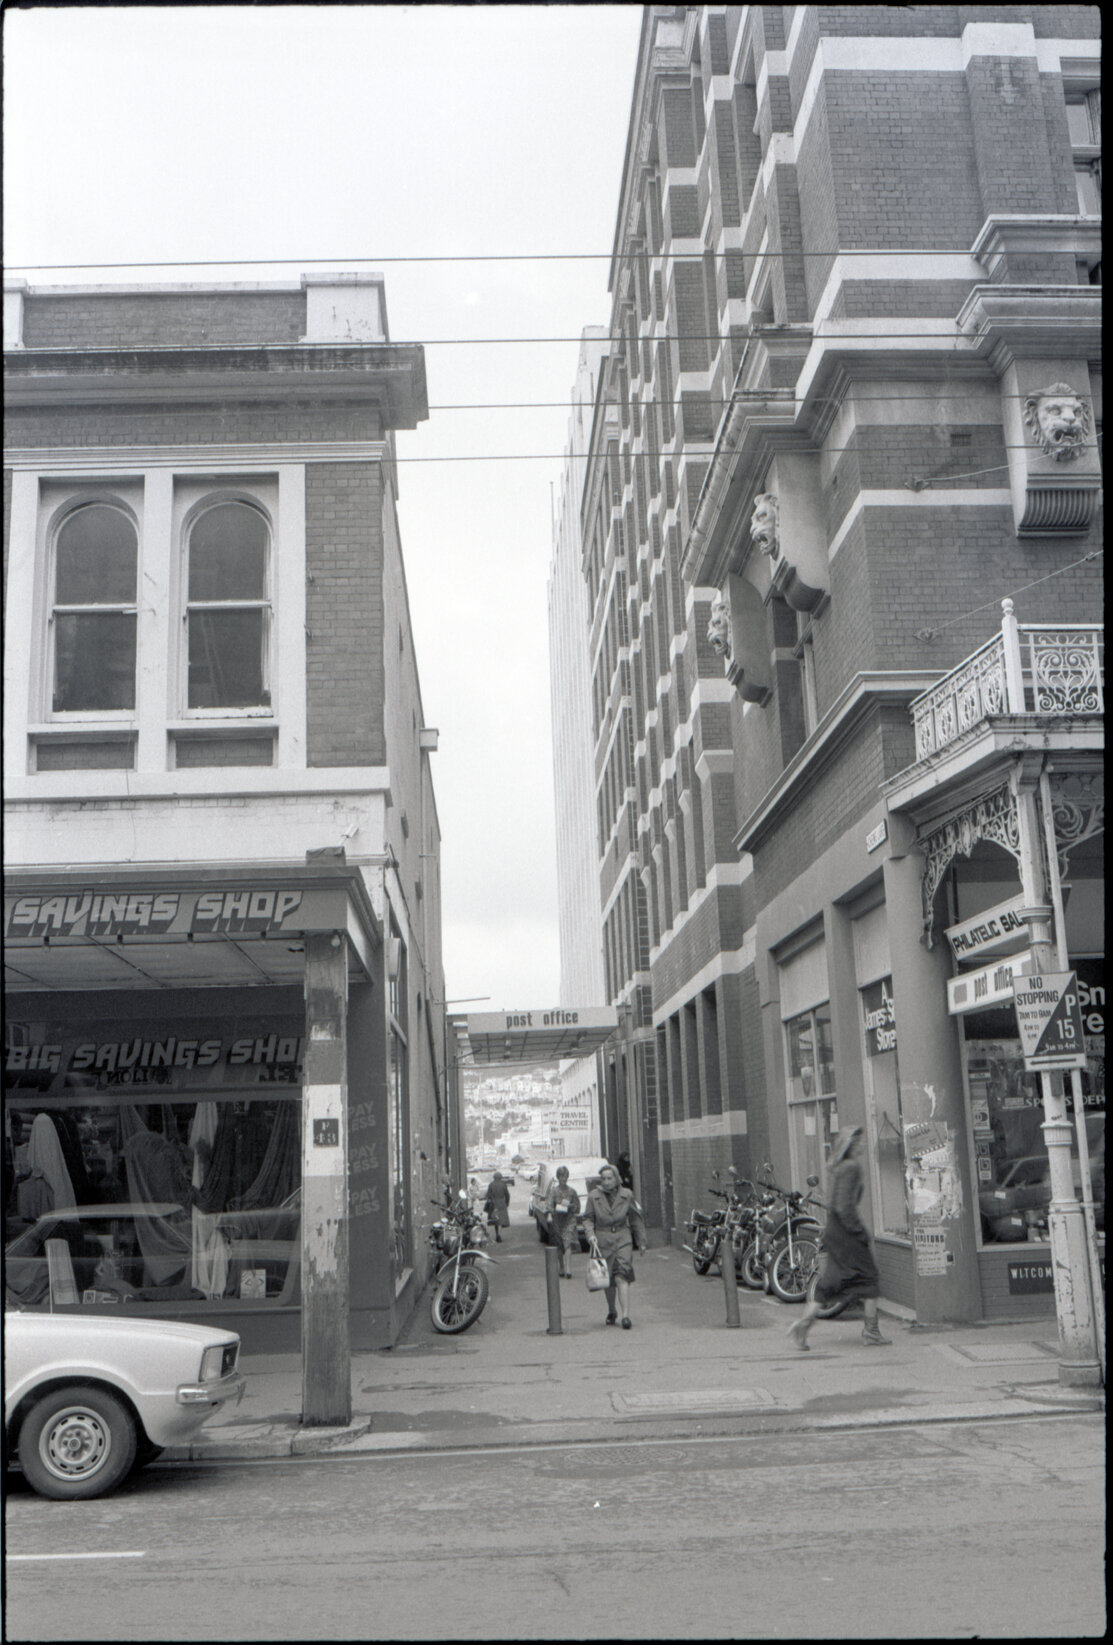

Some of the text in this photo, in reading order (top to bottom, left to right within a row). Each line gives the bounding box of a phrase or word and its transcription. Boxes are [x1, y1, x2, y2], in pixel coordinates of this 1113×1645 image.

[12, 889, 303, 930] SAVINGS SHOP
[952, 919, 1001, 953] PHILATELIC
[974, 965, 1013, 1002] post office
[1028, 976, 1043, 990] NO
[1016, 990, 1059, 1006] STOPPING
[1065, 994, 1077, 1016] P
[506, 1009, 579, 1030] post office
[1056, 1018, 1075, 1040] 15
[876, 1028, 897, 1052] Store
[6, 1034, 306, 1073] BIG SAVINGS SHO
[348, 1100, 374, 1118] PAY
[560, 1111, 588, 1119] TRAVEL
[350, 1114, 377, 1133] ESS
[560, 1119, 589, 1127] CENTRE
[349, 1142, 377, 1161] PAY
[352, 1156, 379, 1175] ESS
[350, 1185, 377, 1204] PAY
[914, 1234, 945, 1244] VISITORS
